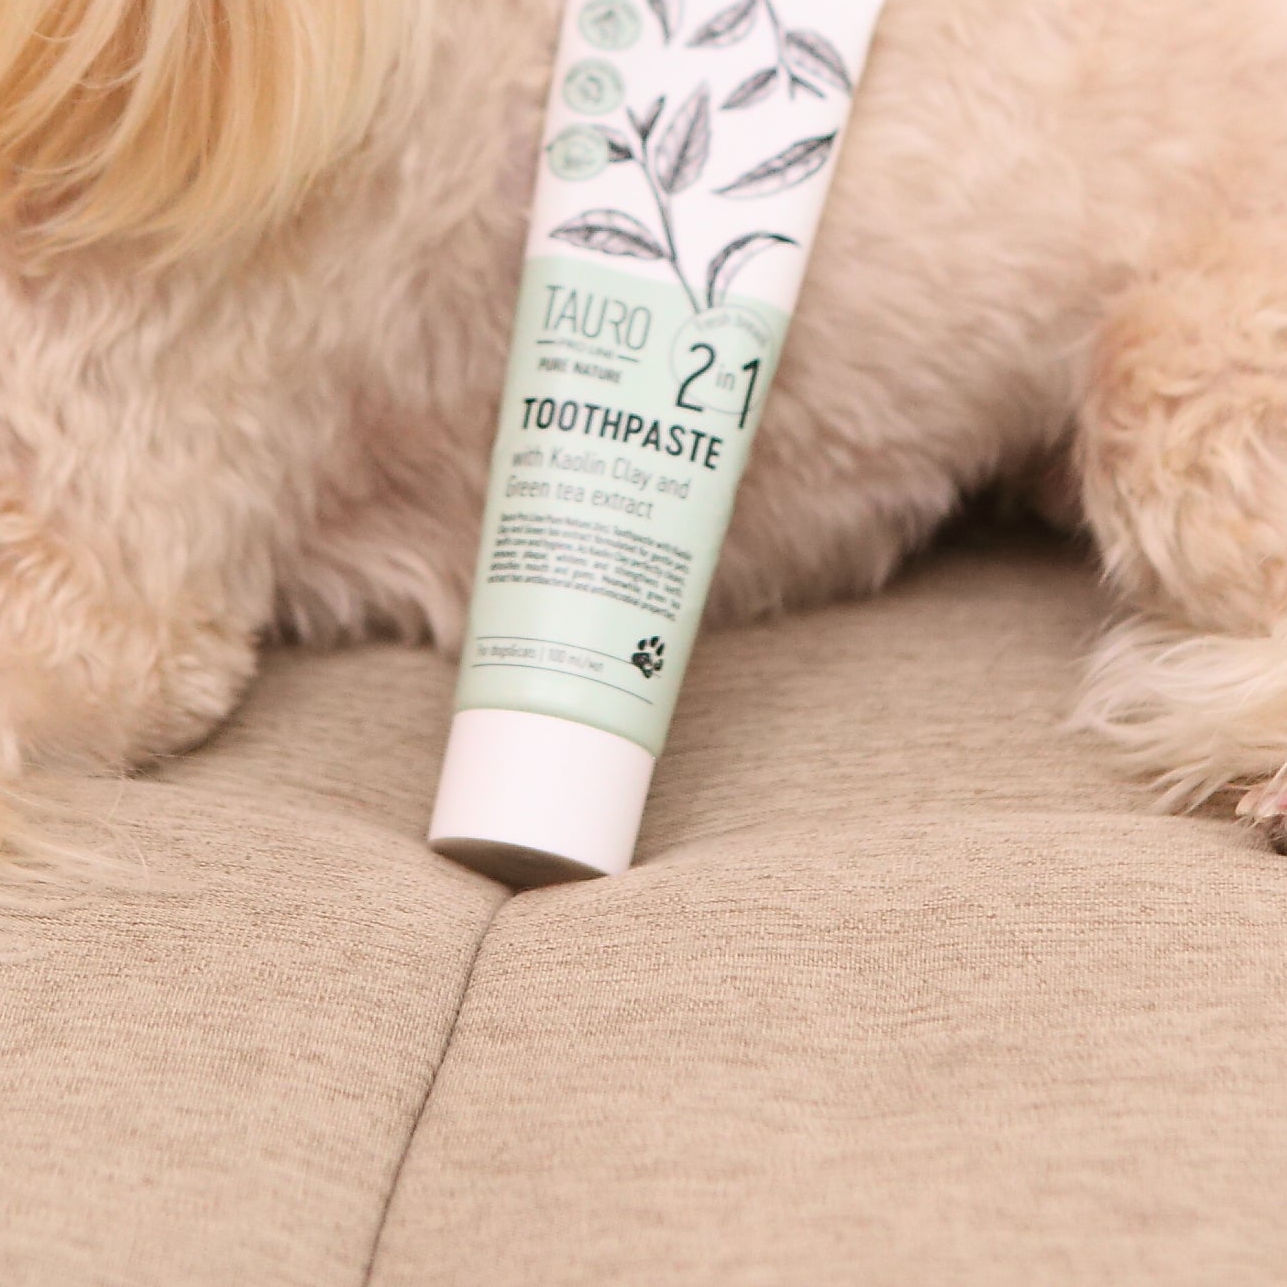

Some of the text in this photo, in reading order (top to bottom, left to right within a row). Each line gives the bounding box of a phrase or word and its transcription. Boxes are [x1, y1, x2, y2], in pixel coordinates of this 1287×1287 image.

[545, 283, 652, 350] TAURO
[675, 342, 716, 413] 2
[738, 357, 761, 430] 1
[521, 397, 723, 471] TOOTHPASTE
[549, 445, 607, 476] Kaolin
[611, 457, 654, 492] Clay
[656, 476, 692, 500] and
[556, 482, 586, 503] tea
[591, 488, 654, 520] extract
